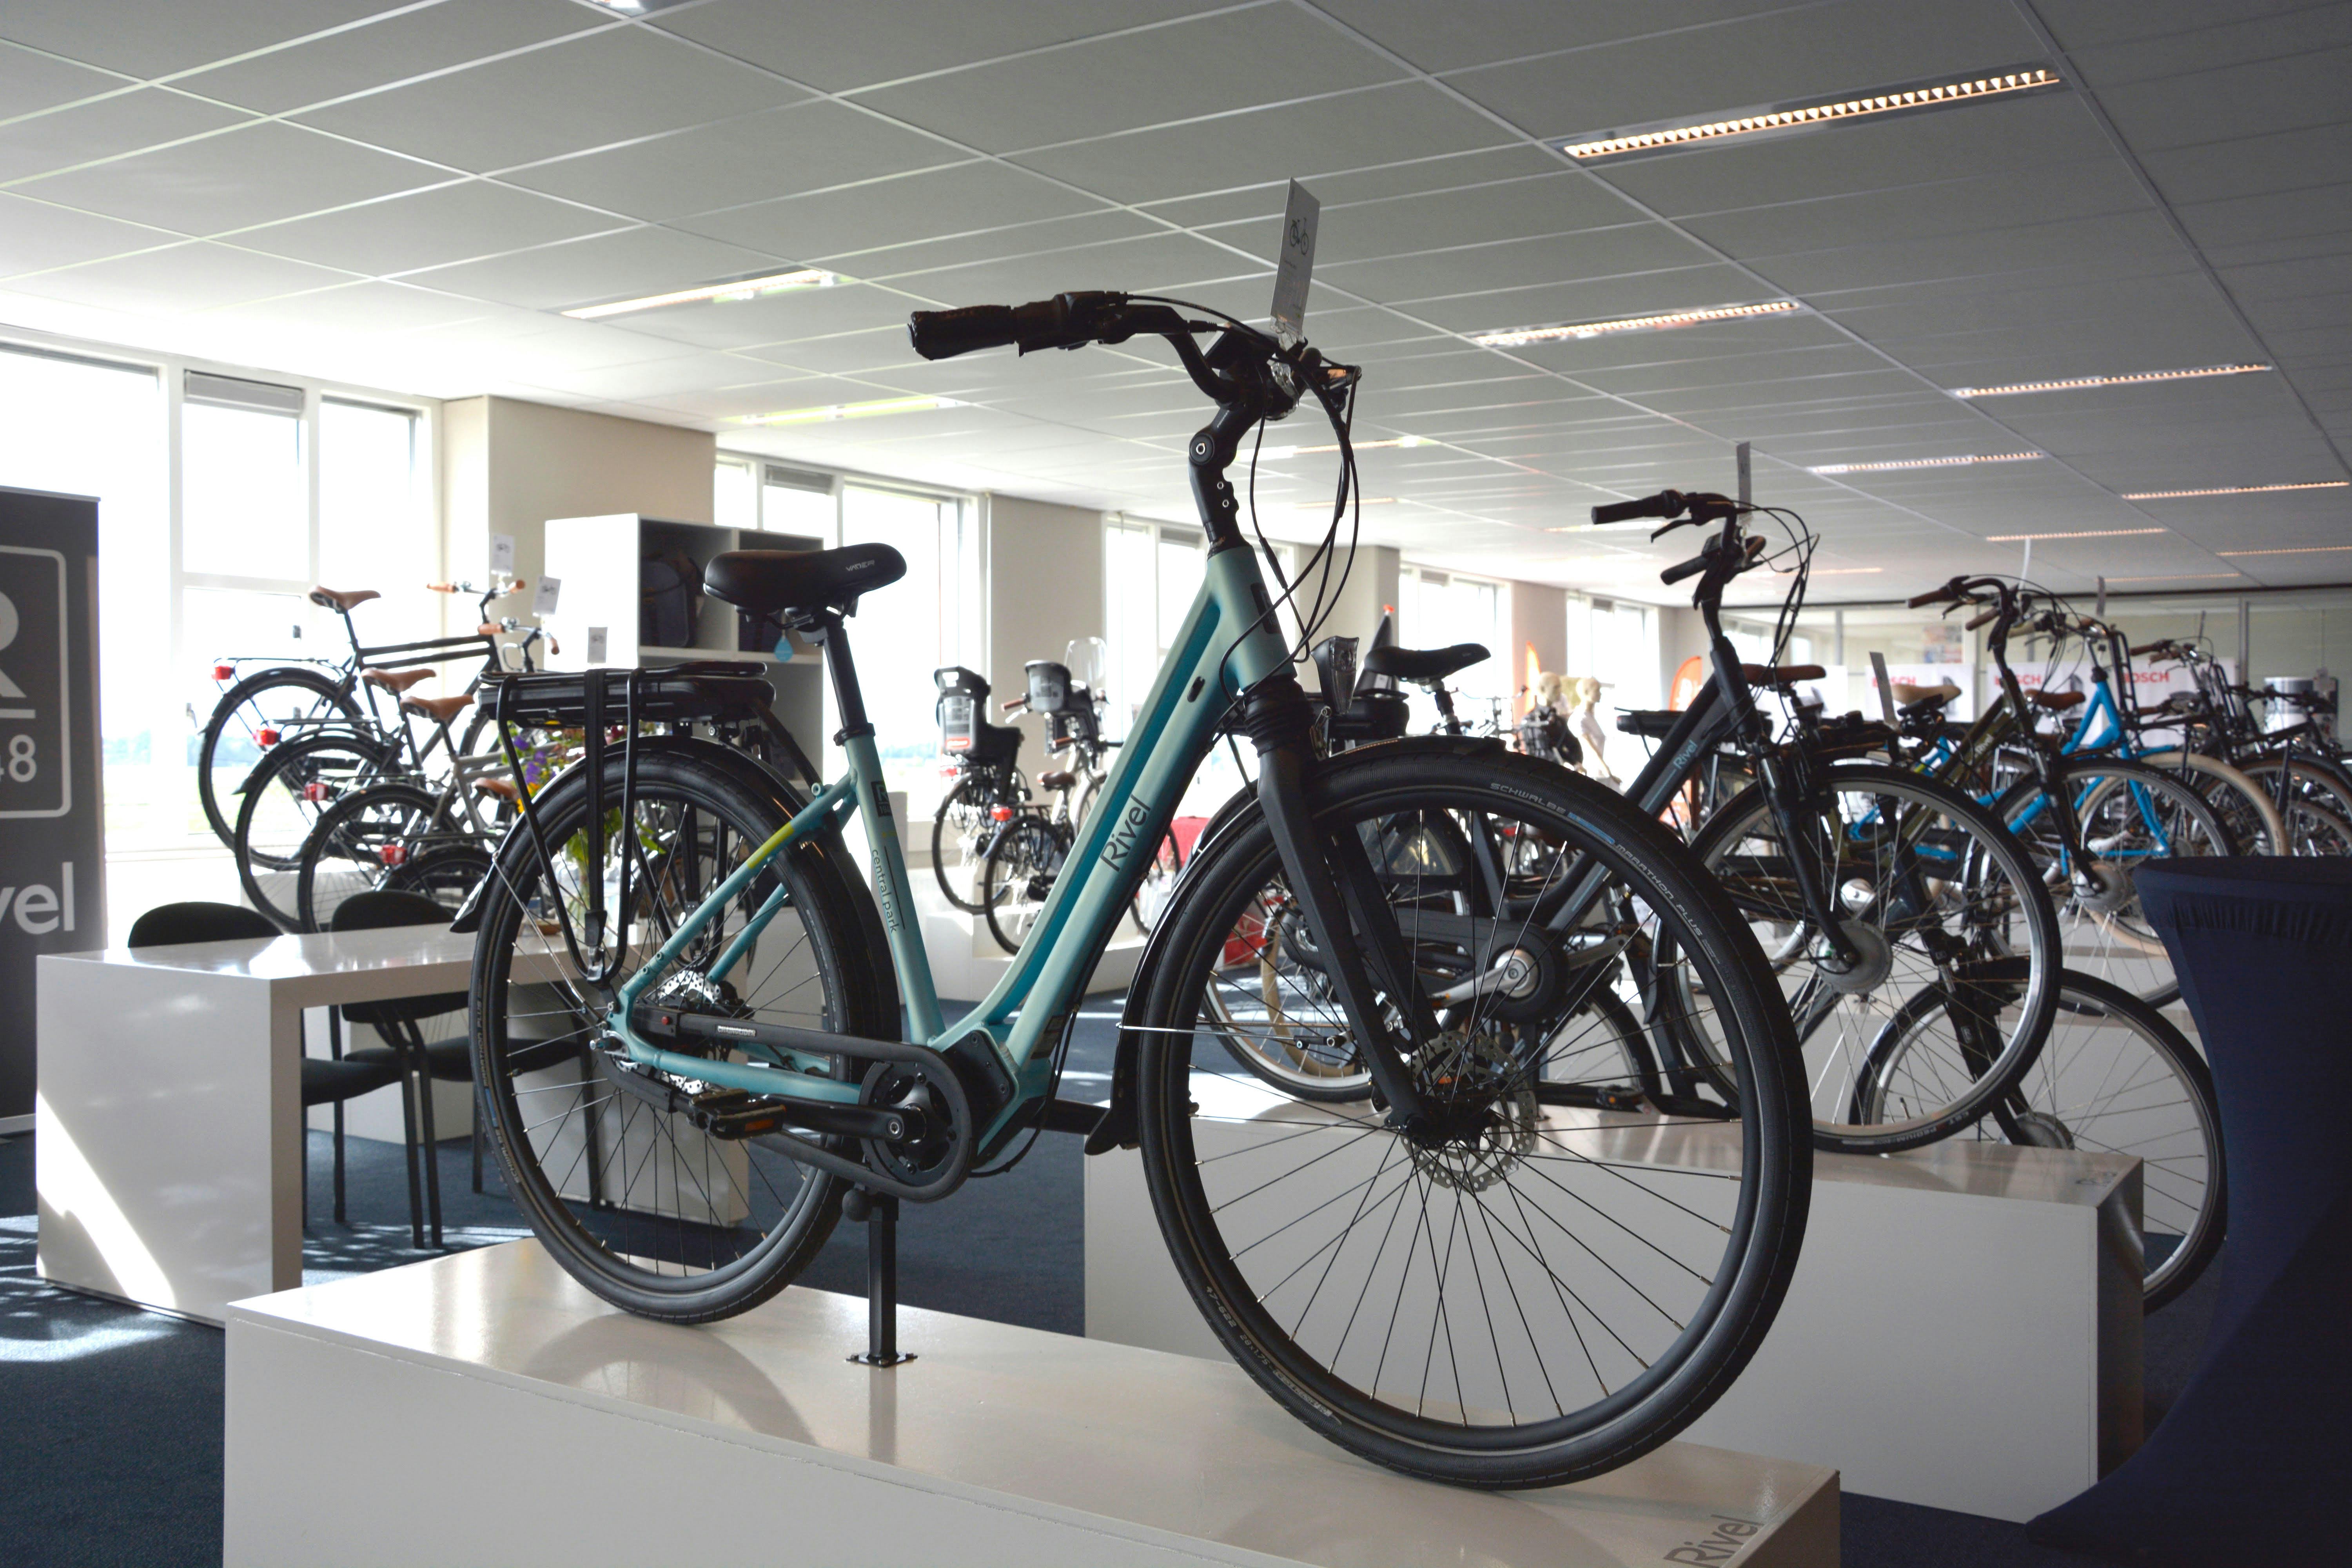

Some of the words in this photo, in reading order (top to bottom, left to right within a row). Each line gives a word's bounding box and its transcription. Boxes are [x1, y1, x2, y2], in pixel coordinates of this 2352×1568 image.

[1673, 739, 1698, 769] Rivel
[1100, 794, 1151, 872] Rivel
[1490, 782, 1566, 815] SCHWALBE
[1615, 844, 1674, 900] MARATHON
[1675, 904, 1703, 937] PLUS
[872, 849, 891, 897] central
[882, 901, 899, 933] park
[1206, 1284, 1237, 1328] 47-622
[1663, 1514, 1765, 1568] Rivel
